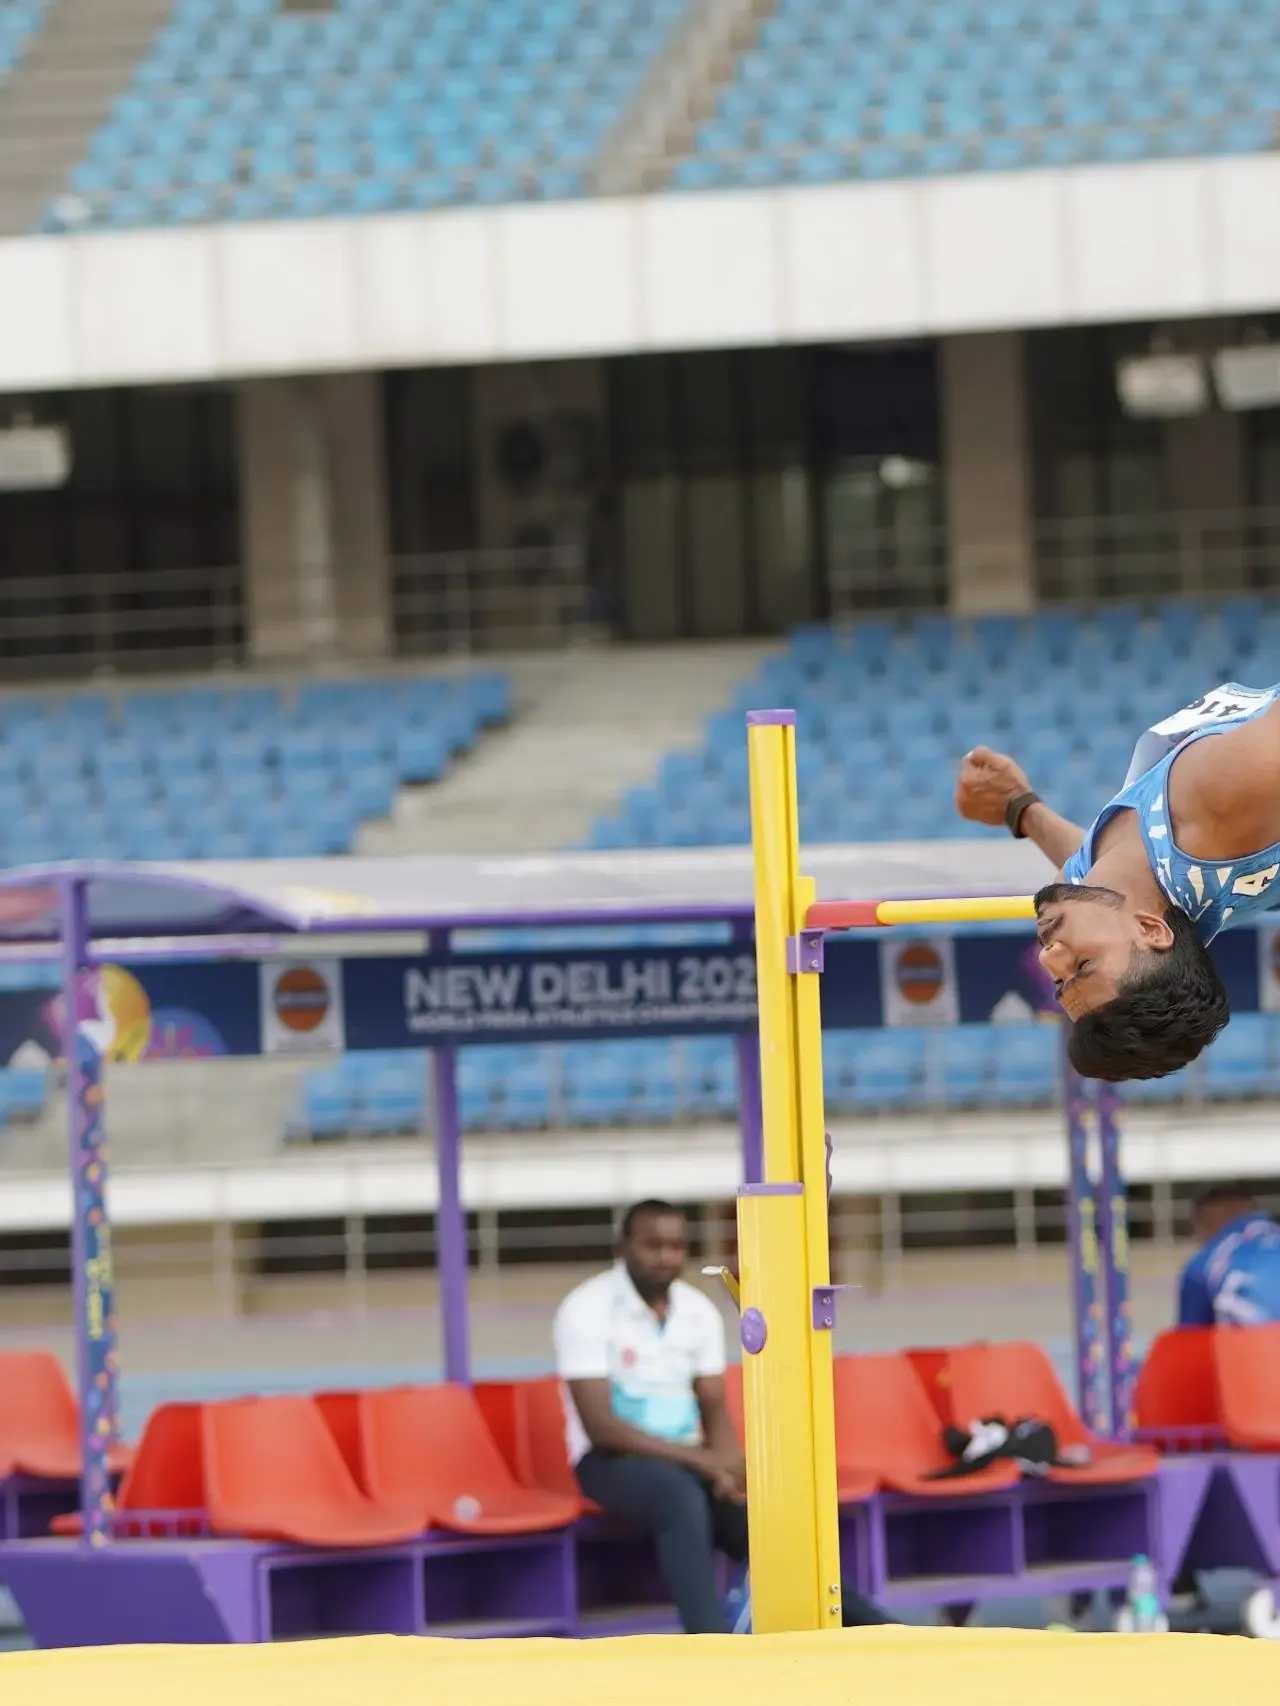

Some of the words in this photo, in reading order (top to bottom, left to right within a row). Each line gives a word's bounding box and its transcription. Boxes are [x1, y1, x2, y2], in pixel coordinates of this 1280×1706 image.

[405, 965, 520, 1009] NEW
[531, 959, 671, 1003] DELHI
[679, 954, 757, 999] 202
